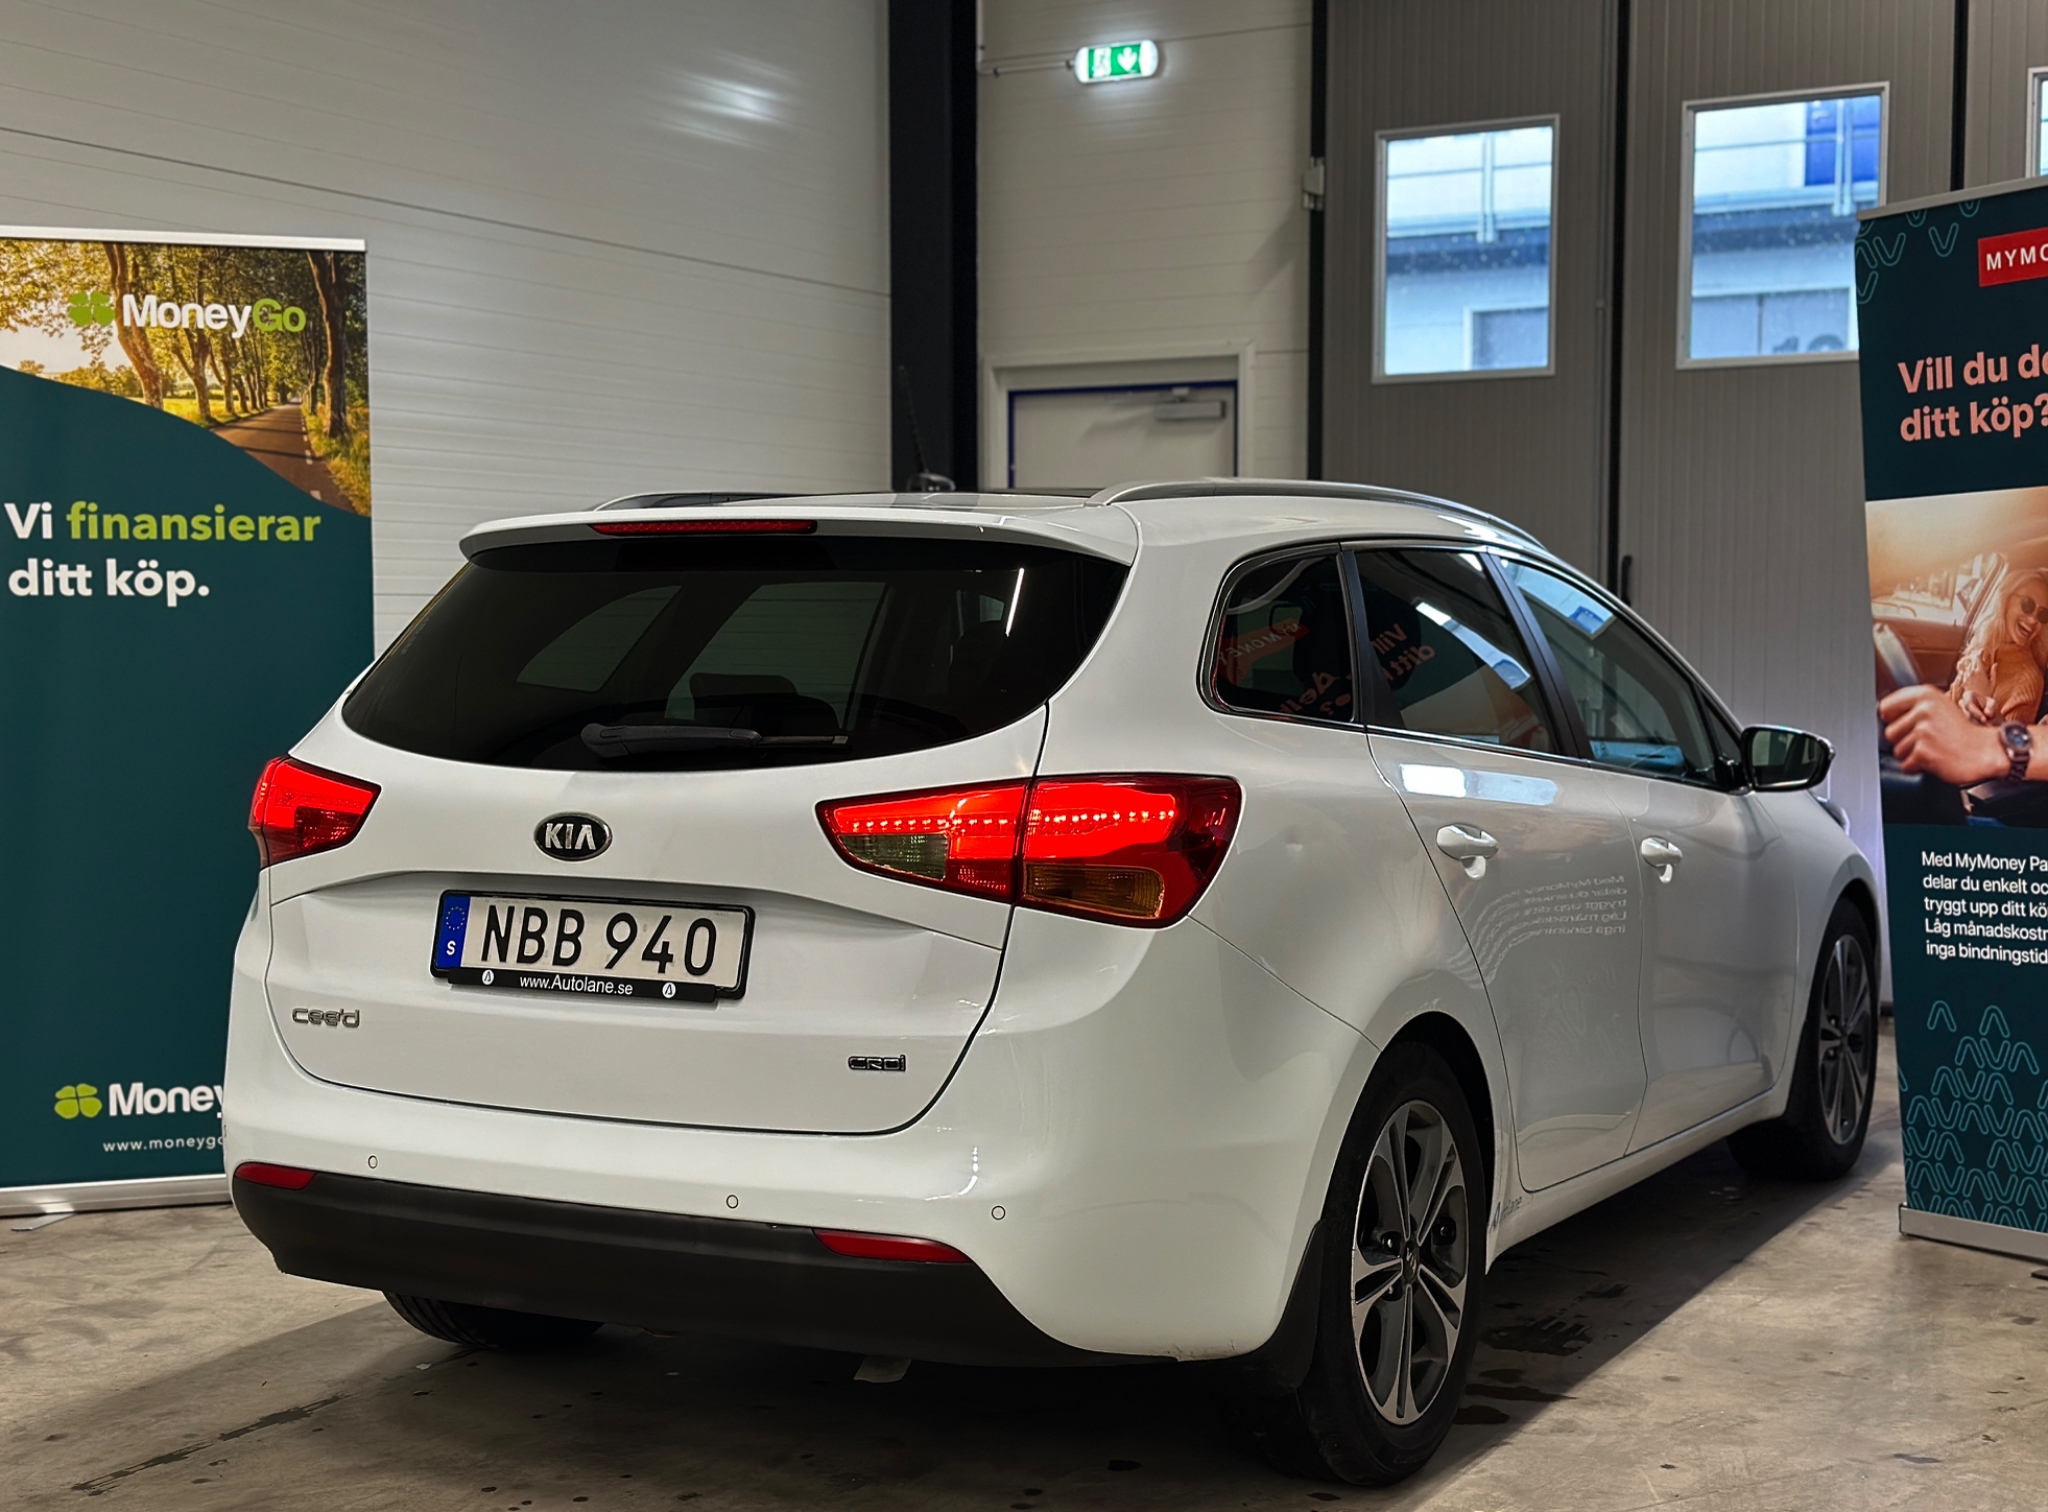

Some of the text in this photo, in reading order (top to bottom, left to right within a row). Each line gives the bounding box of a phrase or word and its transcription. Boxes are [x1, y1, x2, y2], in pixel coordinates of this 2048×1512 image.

[122, 294, 306, 339] MoneyGo
[1897, 344, 2048, 394] Vill du d
[1900, 393, 2048, 442] ditt köp?
[5, 501, 321, 542] Vi finansierar
[8, 558, 210, 607] ditt köp.
[545, 822, 597, 850] KIA
[1921, 851, 1952, 867] Med
[1955, 852, 2026, 874] MyMoney
[1923, 874, 1957, 890] delar
[1961, 876, 1980, 891] du
[1983, 878, 2028, 894] enkelt
[1924, 897, 1967, 916] tryggt
[1970, 902, 1999, 918] upp
[2001, 901, 2027, 917] ditt
[446, 904, 717, 976] S NBB 940
[1925, 918, 1951, 938] Låg
[1926, 940, 1956, 960] inga
[520, 974, 633, 996] www.Autolane.se
